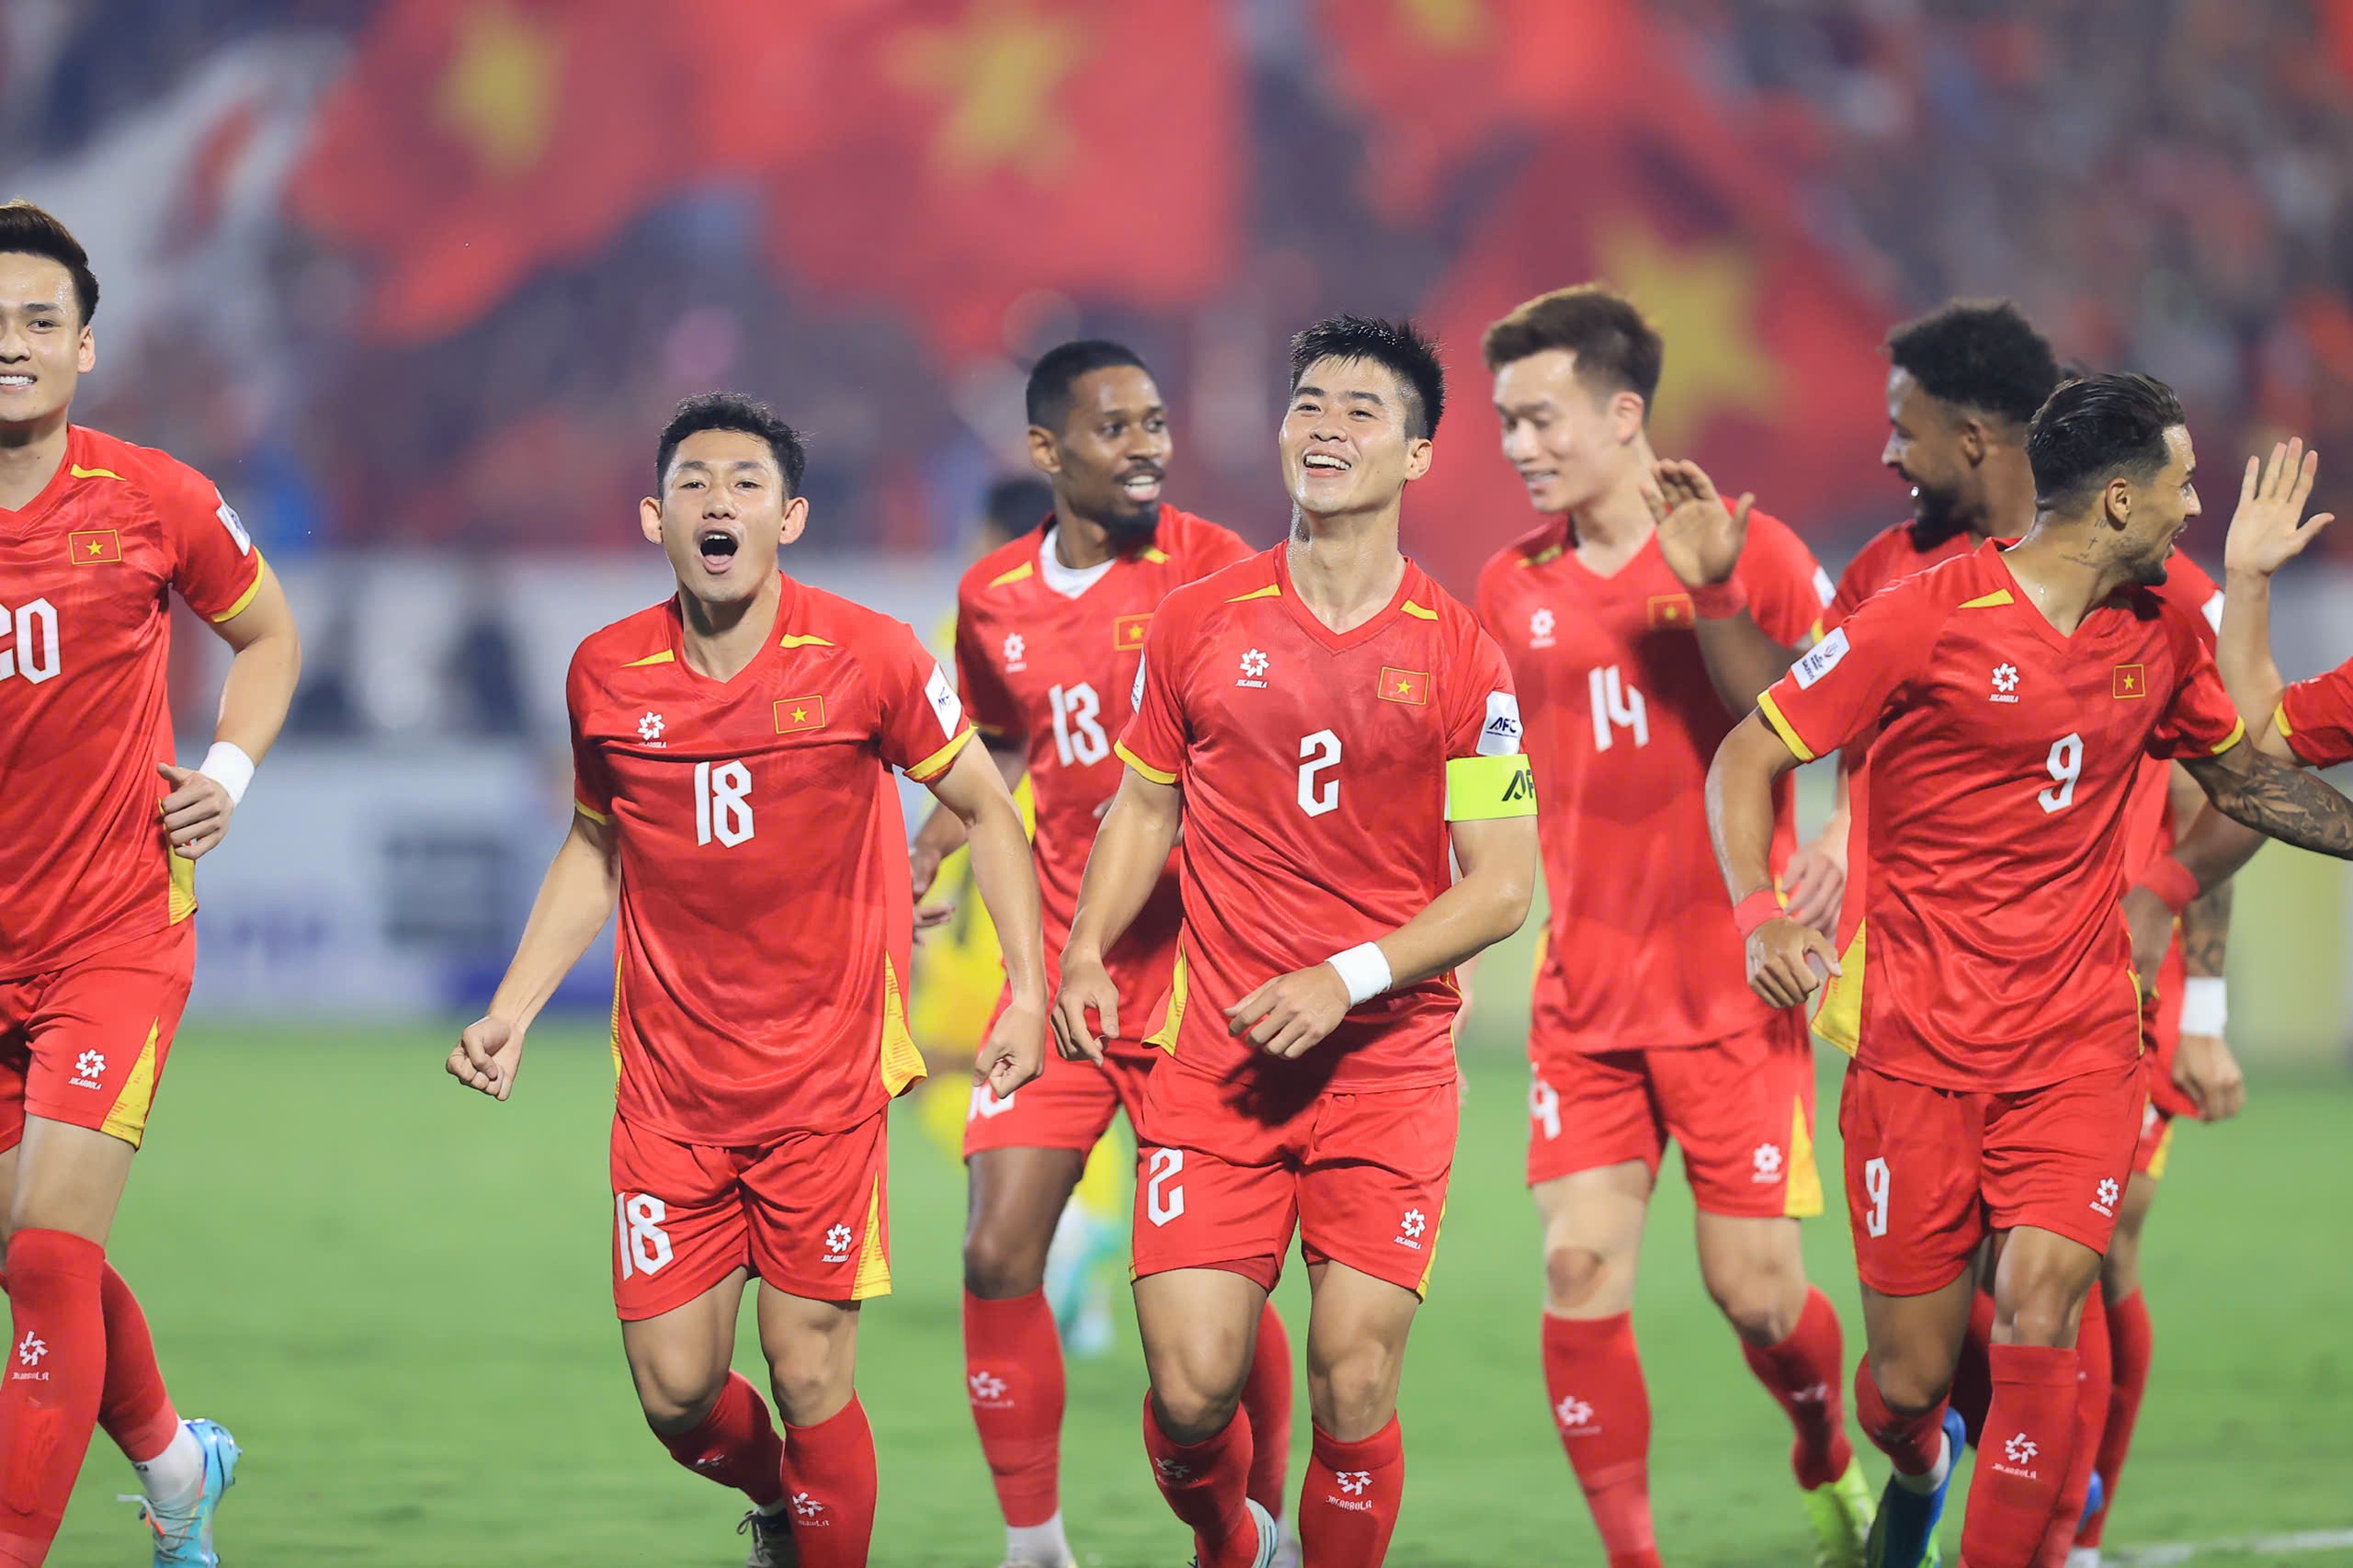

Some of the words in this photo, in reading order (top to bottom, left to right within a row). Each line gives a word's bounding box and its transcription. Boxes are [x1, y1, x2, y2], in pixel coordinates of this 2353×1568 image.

[1048, 682, 1110, 767] 13
[1489, 717, 1518, 733] AFC
[1588, 665, 1650, 753] 14
[694, 760, 756, 848] 18
[1297, 728, 1343, 818] 2
[2037, 732, 2085, 814] 9
[1147, 1147, 1185, 1228] 2
[1864, 1156, 1891, 1239] 9
[616, 1192, 675, 1281] 18
